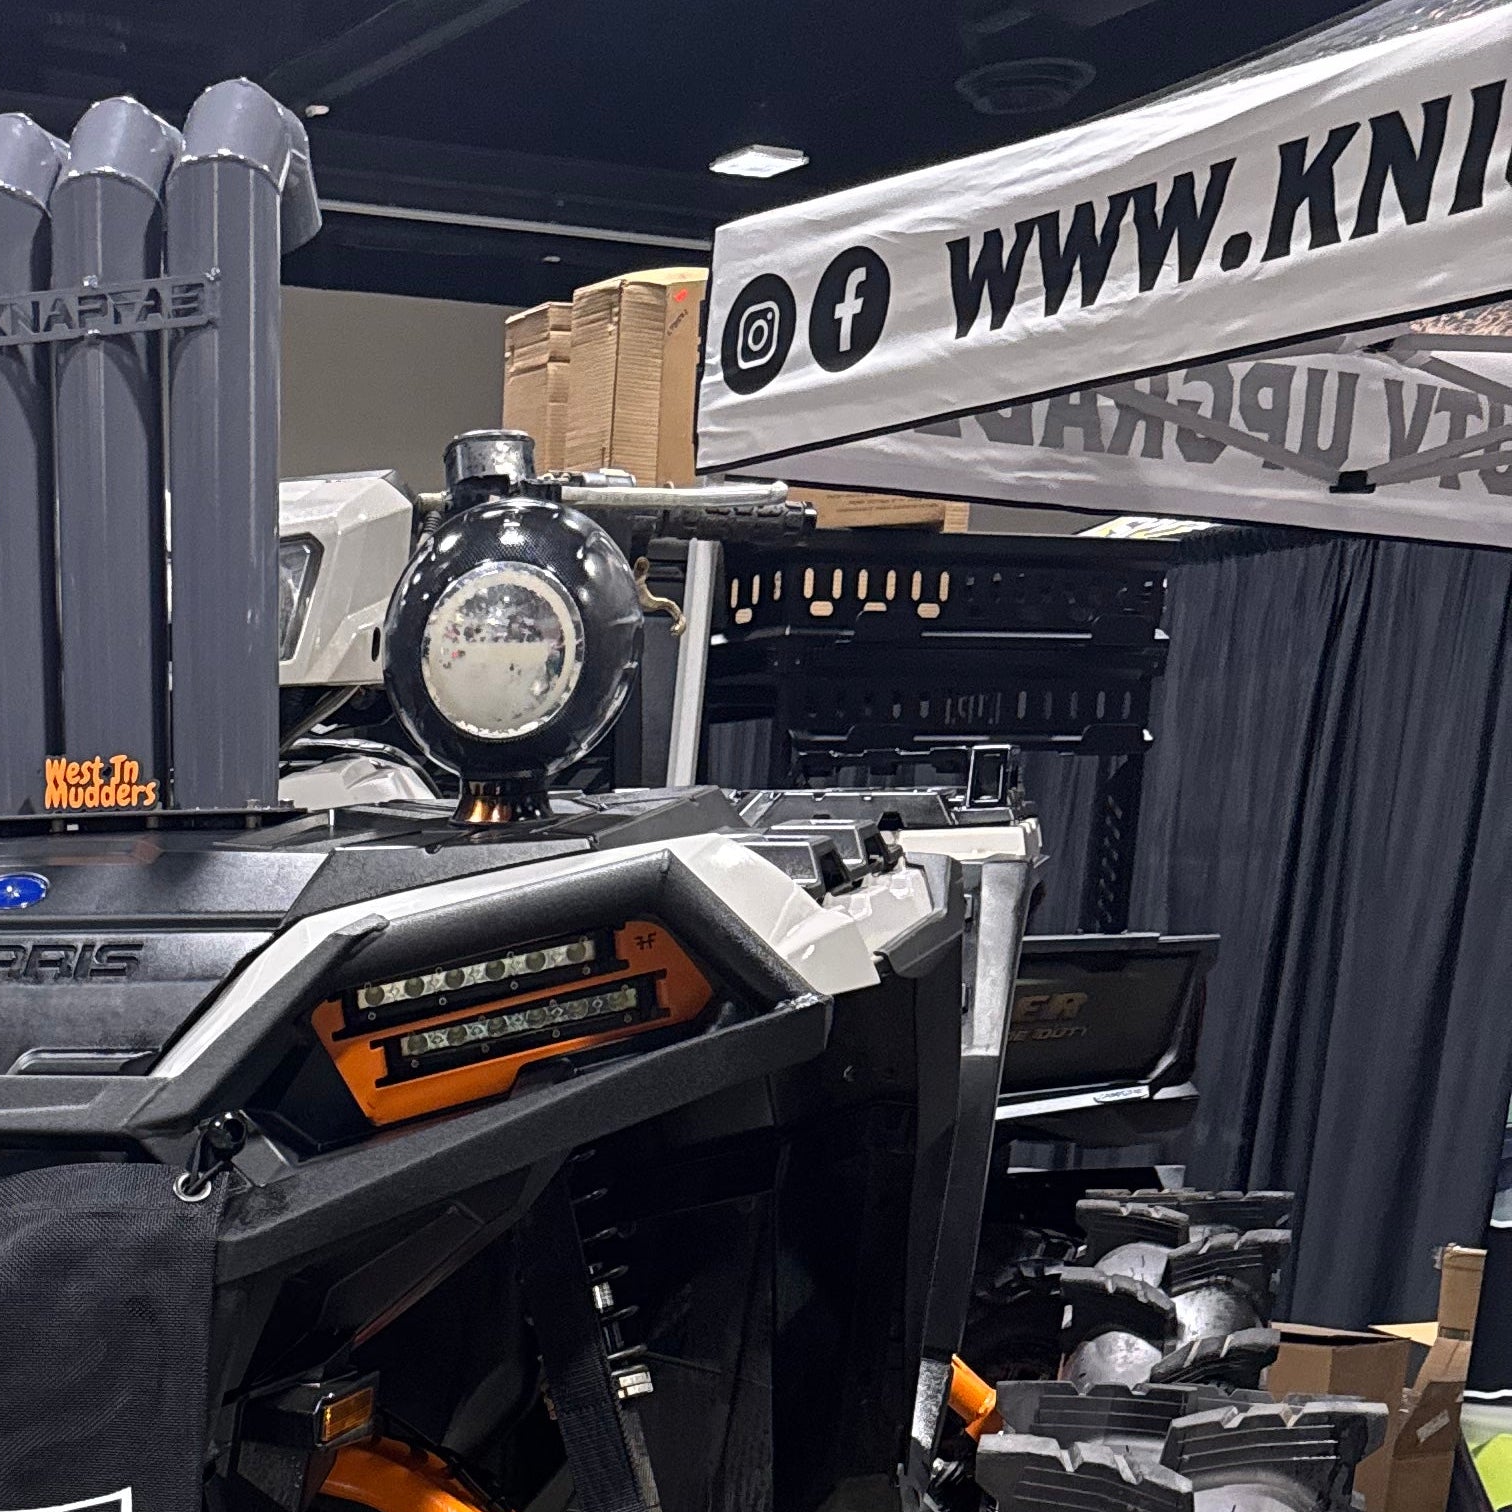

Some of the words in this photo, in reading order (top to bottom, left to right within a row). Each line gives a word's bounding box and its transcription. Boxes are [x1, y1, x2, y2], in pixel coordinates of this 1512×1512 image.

[946, 79, 1512, 340] WWW.KNI
[45, 755, 104, 785] West
[45, 781, 157, 810] Mudders
